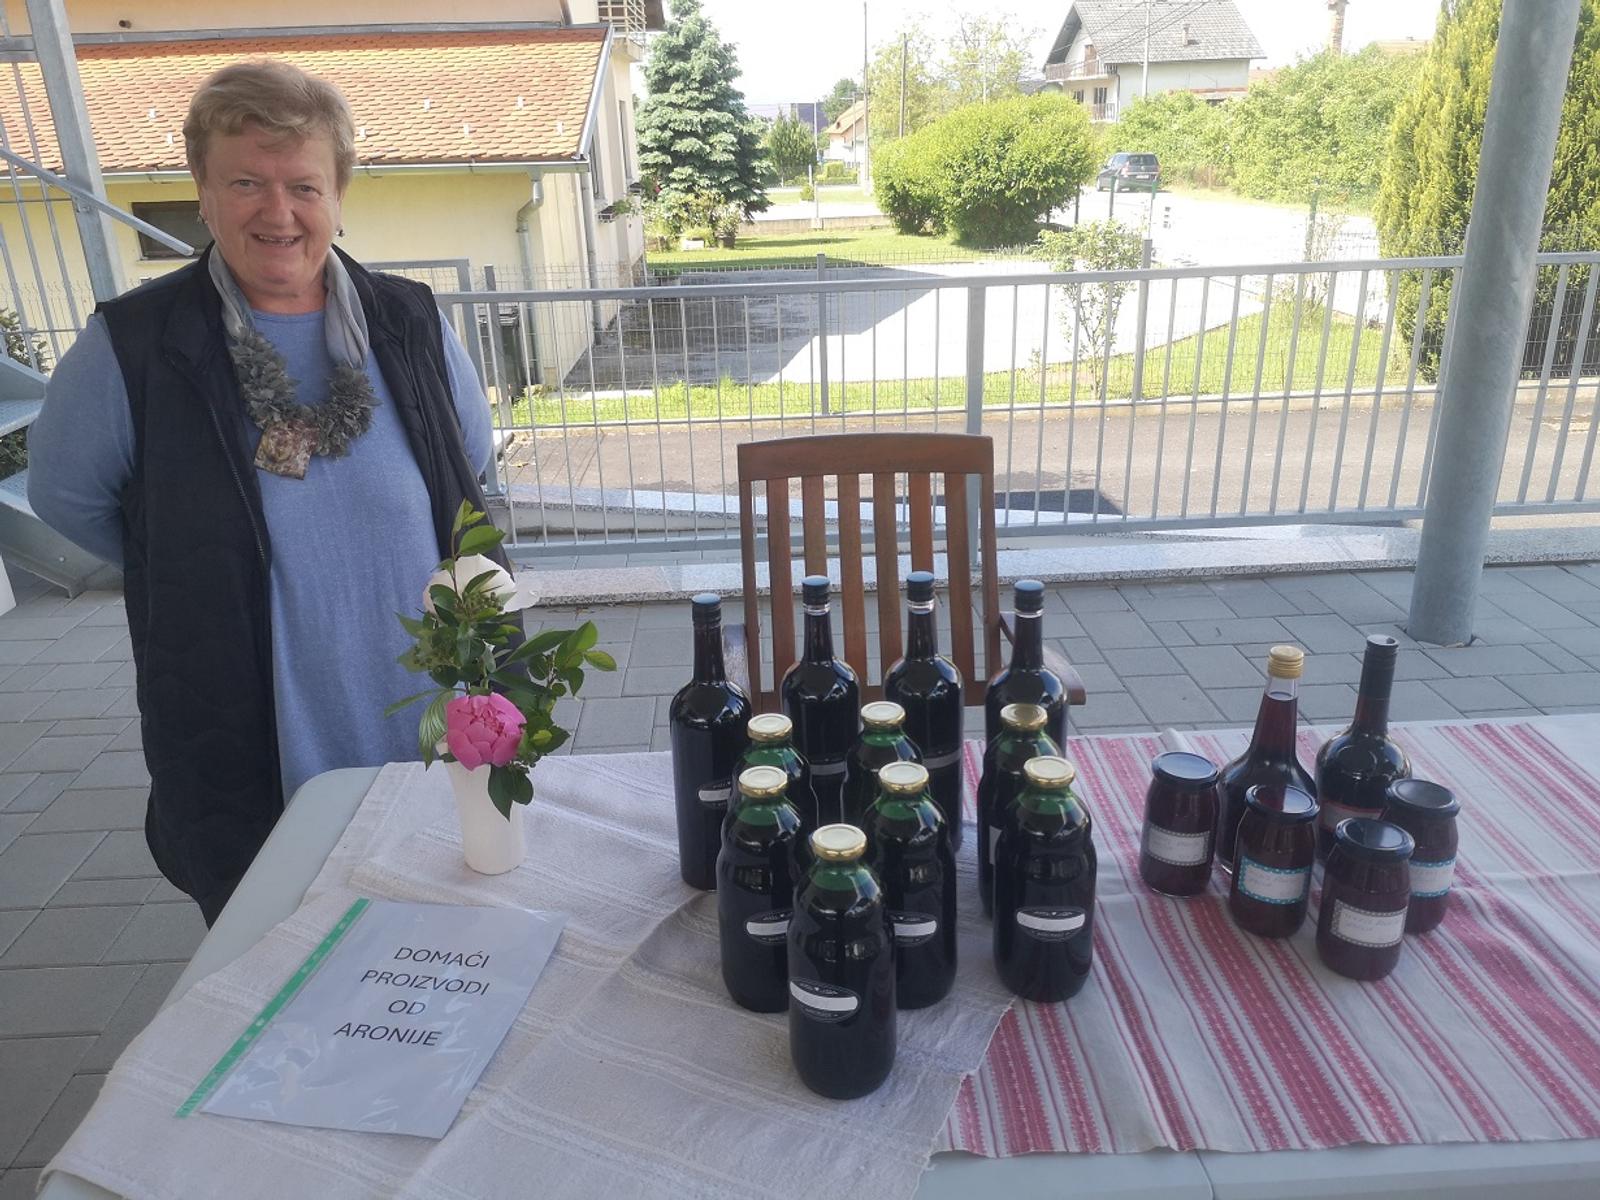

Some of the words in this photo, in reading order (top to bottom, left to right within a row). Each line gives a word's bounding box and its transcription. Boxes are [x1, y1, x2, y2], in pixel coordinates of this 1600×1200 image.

[394, 947, 490, 969] DOMAĆI
[360, 969, 490, 996] PROIZVODI
[388, 999, 426, 1015] OD
[333, 1022, 442, 1046] ARONIJE
